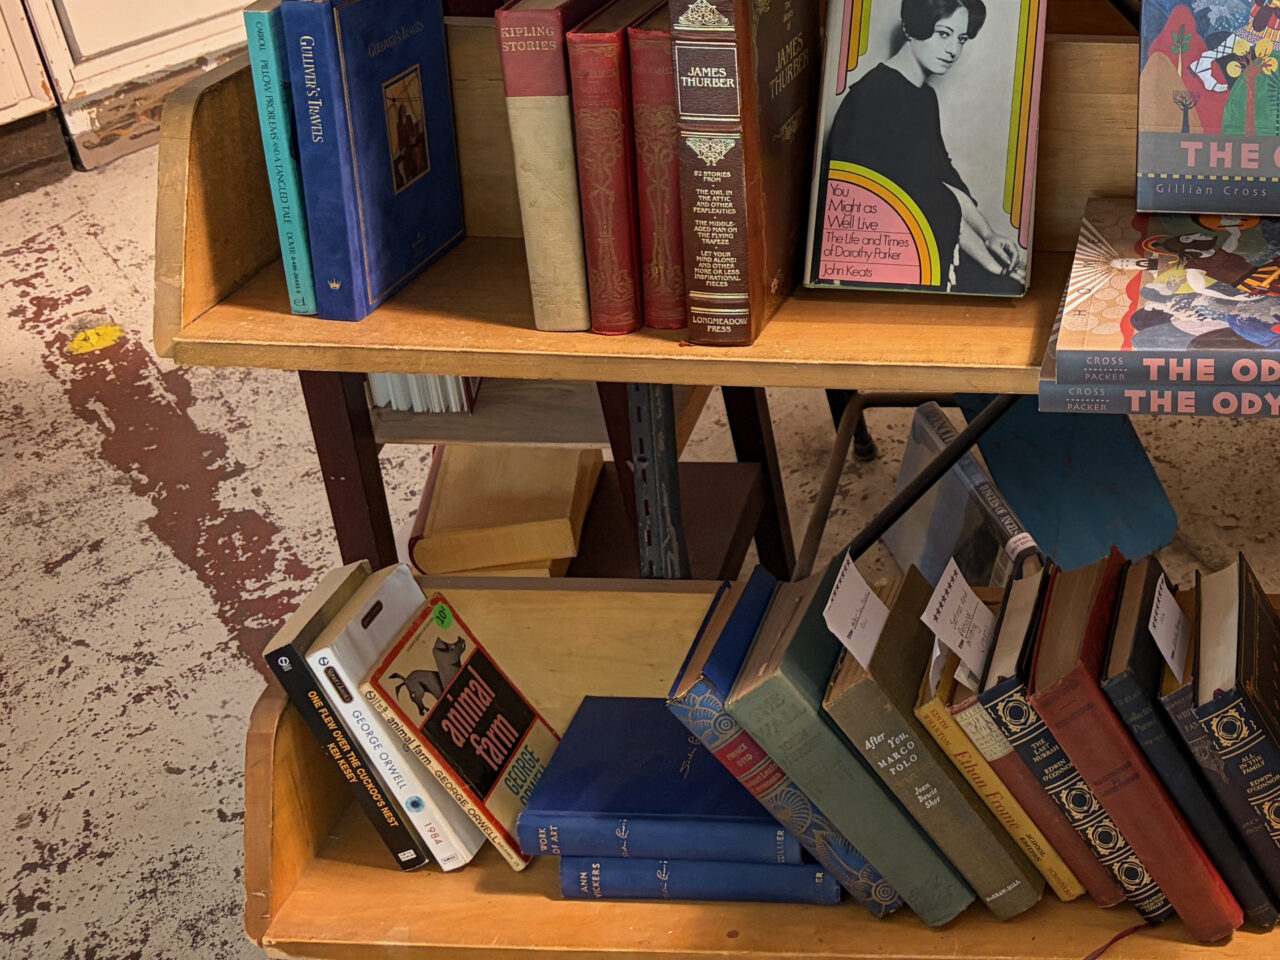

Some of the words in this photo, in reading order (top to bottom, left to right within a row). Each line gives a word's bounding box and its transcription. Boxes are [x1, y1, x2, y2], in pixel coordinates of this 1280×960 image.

[501, 26, 554, 39] KIPLING
[502, 39, 557, 51] STORIES
[299, 36, 320, 98] GULLIVER'S
[688, 67, 727, 79] JAMES
[680, 76, 736, 89] THURBER
[306, 100, 324, 143] TRAVELS
[1181, 141, 1259, 169] THE
[830, 184, 849, 198] You
[1156, 183, 1213, 196] Gillian
[1223, 185, 1267, 197] Cross
[829, 199, 862, 216] Might
[863, 204, 877, 214] as
[828, 215, 855, 229] Well
[857, 219, 878, 231] Live
[1143, 358, 1215, 381] THE
[442, 665, 495, 748] animal
[471, 713, 519, 771] farm
[308, 691, 322, 709] ONE
[318, 704, 336, 731] FLEW
[332, 730, 350, 754] OVER
[346, 751, 360, 770] THE
[357, 768, 385, 808] CUCKOO'S
[381, 805, 399, 828] NEST
[954, 750, 988, 789] Ethan
[985, 790, 1021, 830] Frome
